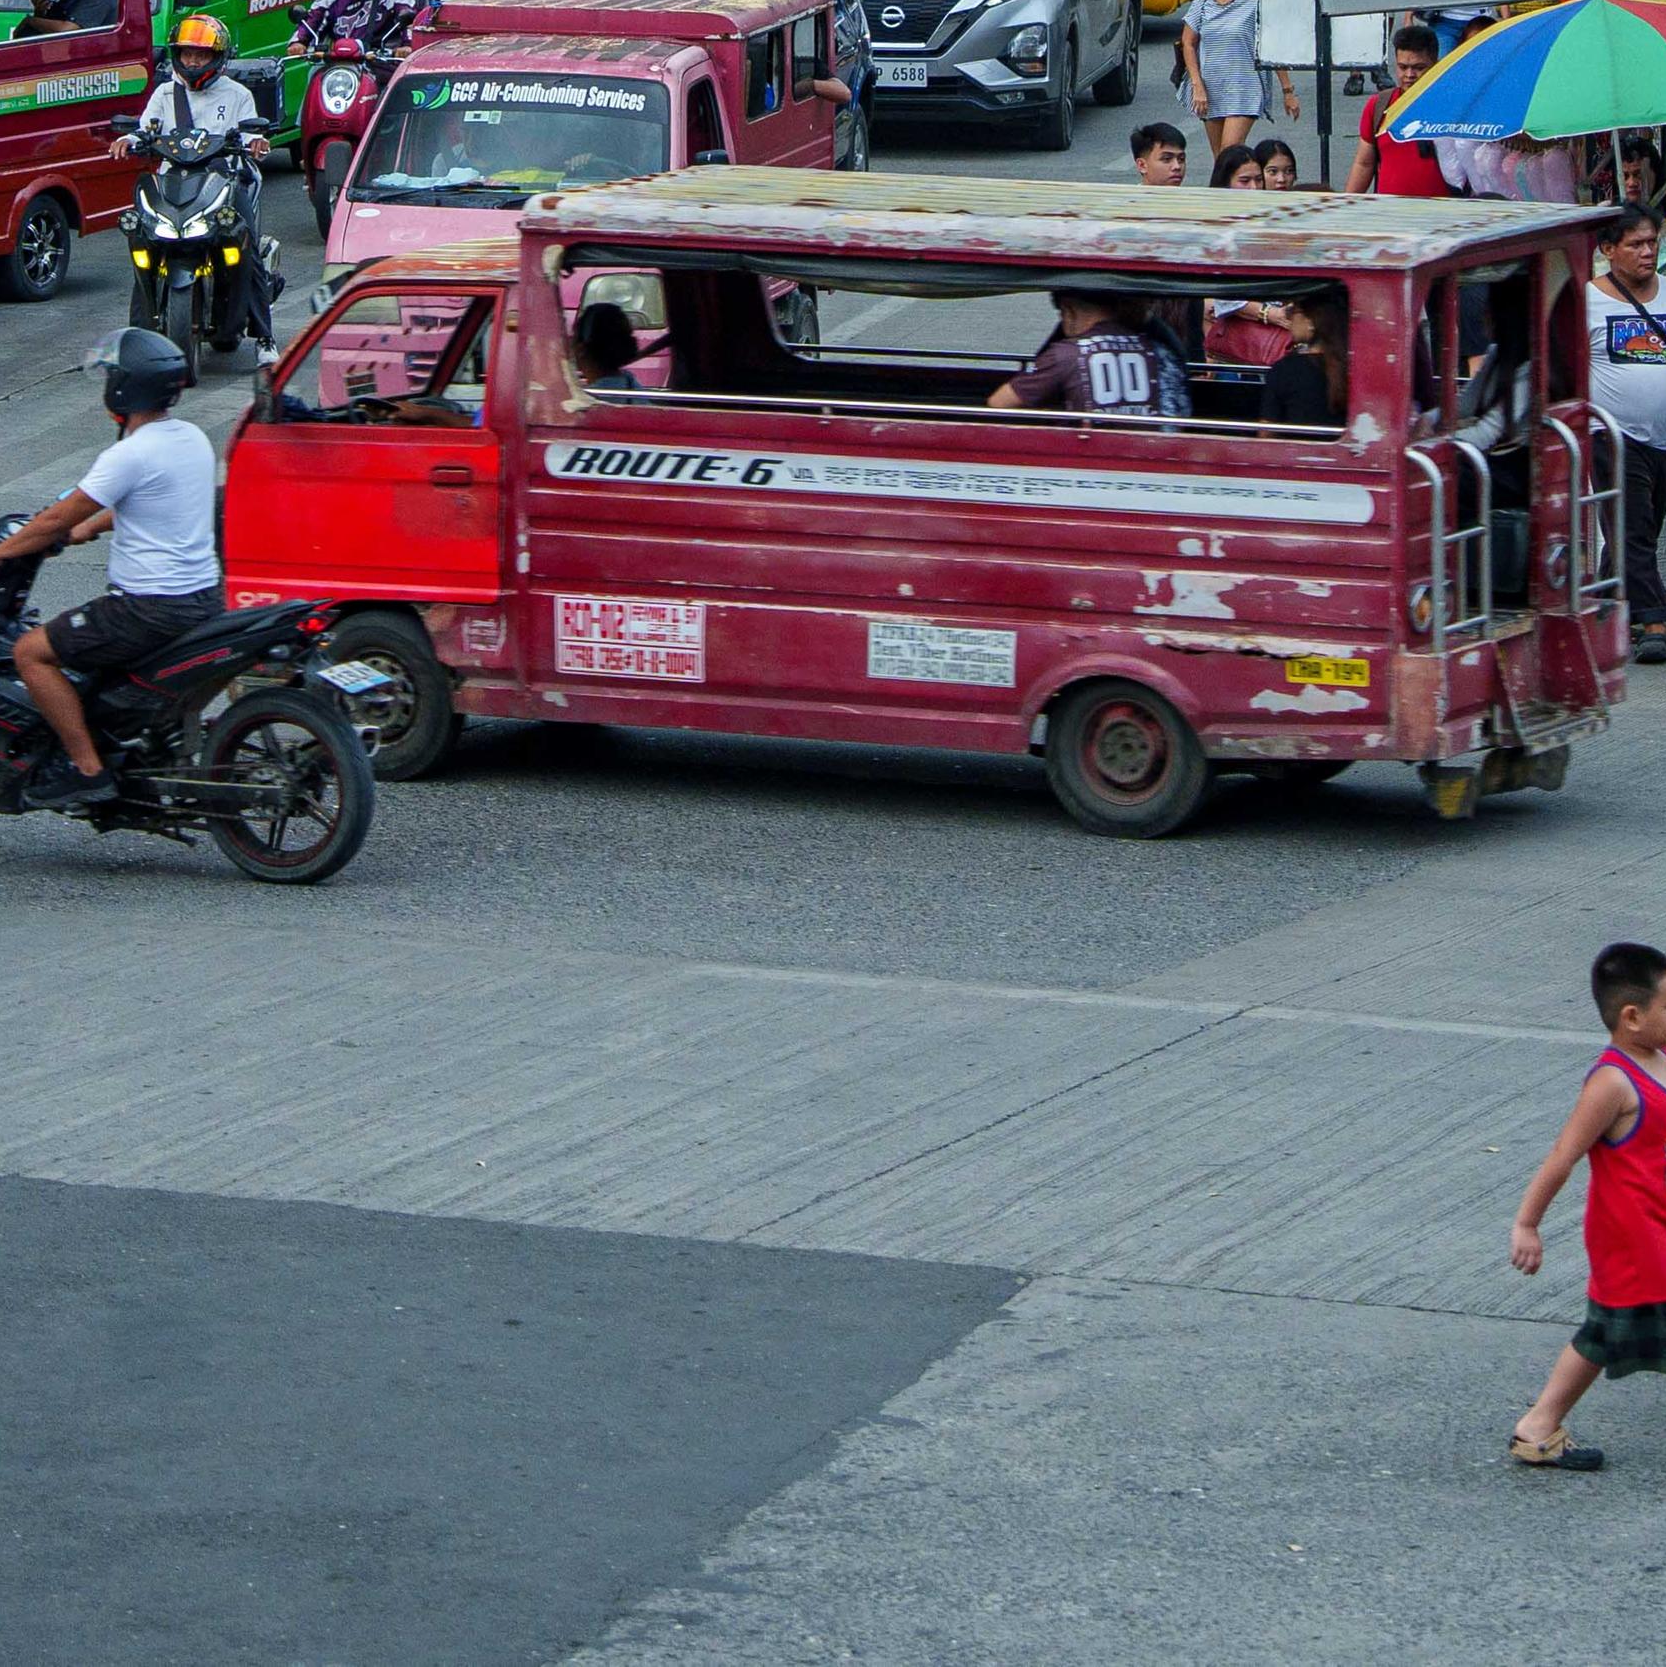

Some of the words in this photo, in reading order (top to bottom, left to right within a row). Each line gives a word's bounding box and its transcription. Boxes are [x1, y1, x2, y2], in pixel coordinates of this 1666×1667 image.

[891, 65, 927, 84] 6588
[589, 85, 645, 112] Services
[1421, 120, 1505, 137] MICROMATIC
[1086, 352, 1152, 406] 00
